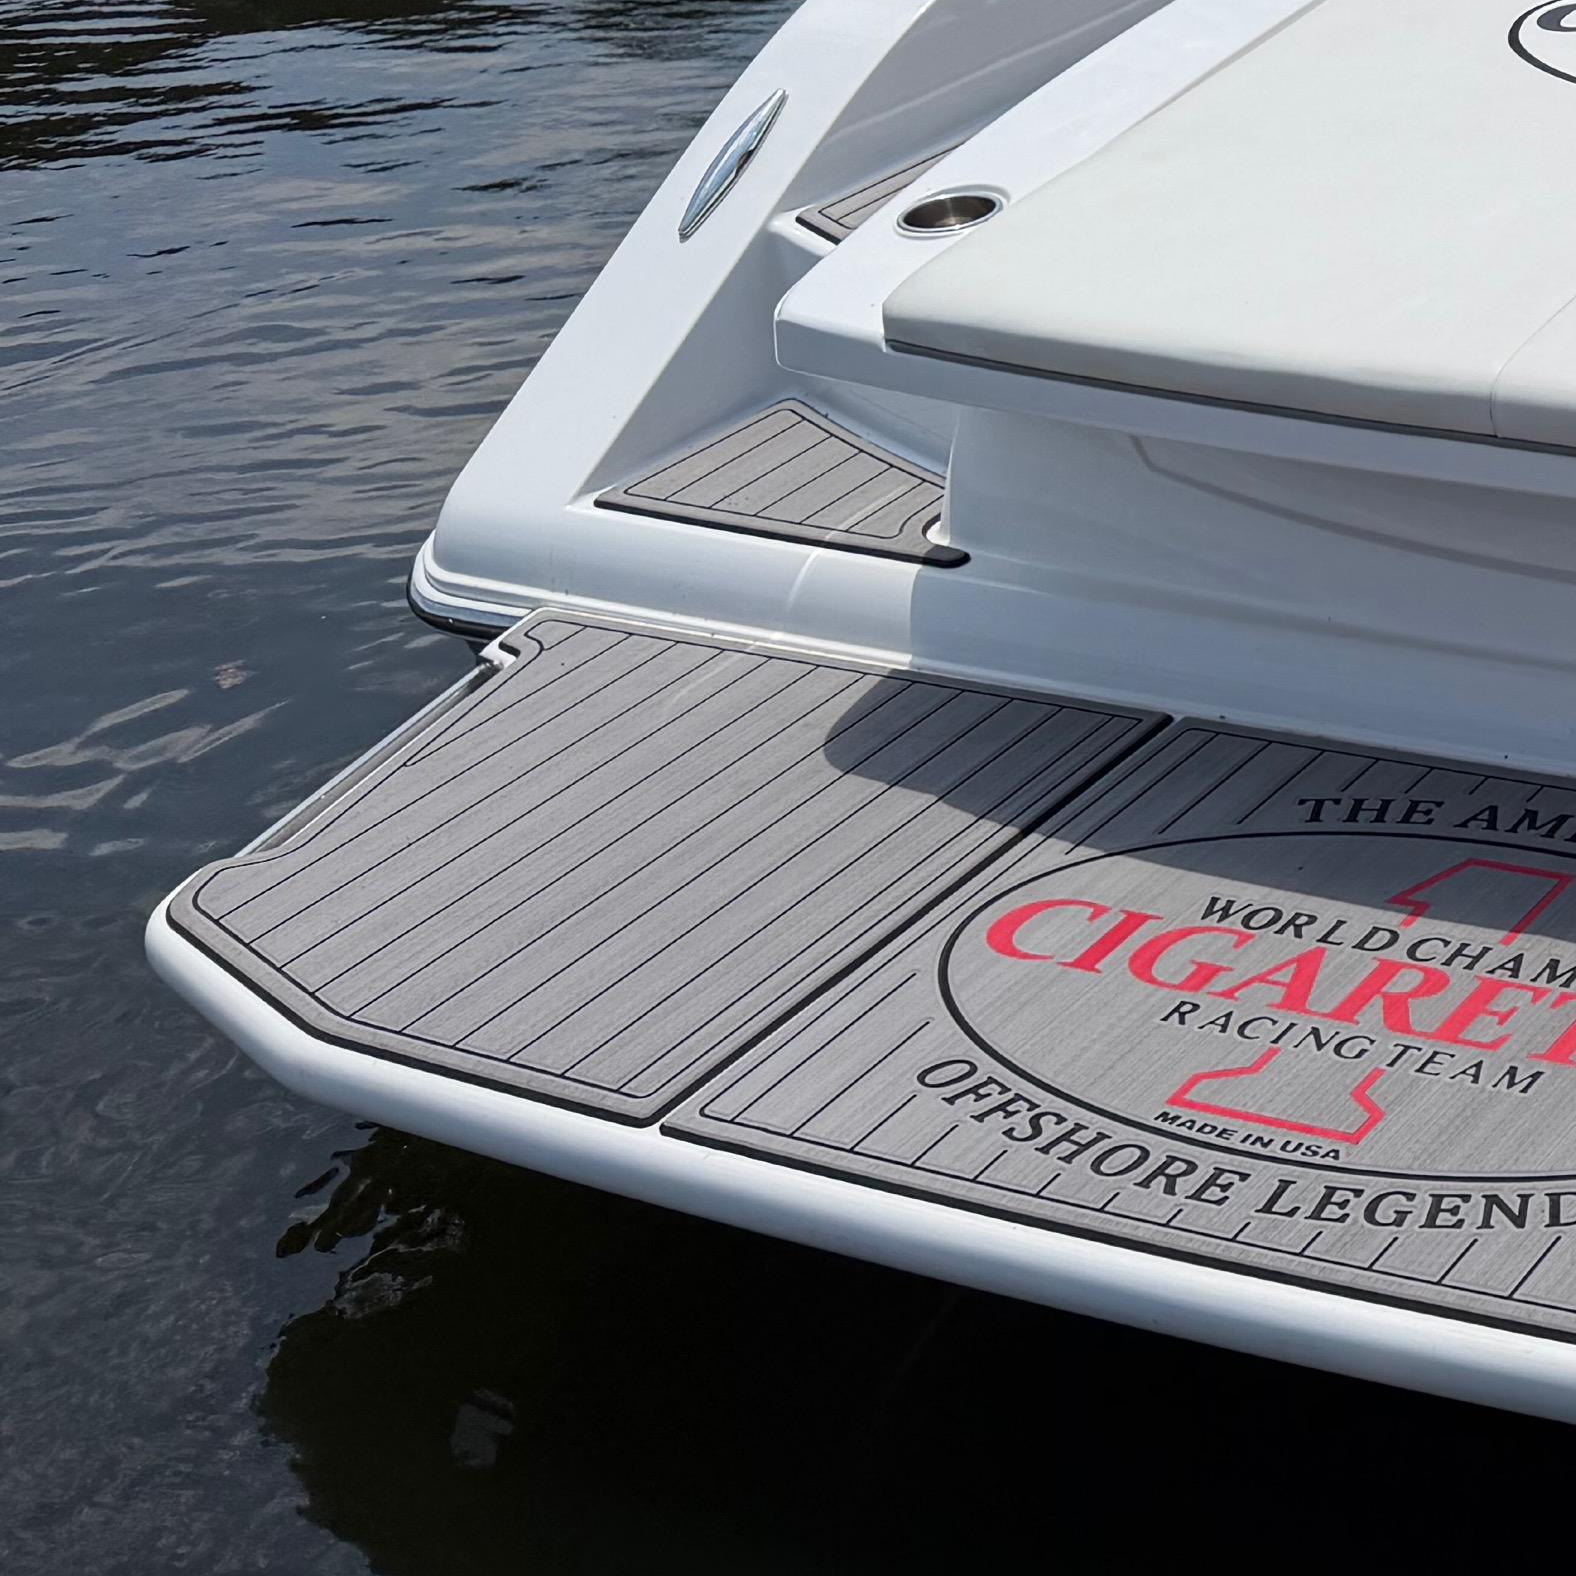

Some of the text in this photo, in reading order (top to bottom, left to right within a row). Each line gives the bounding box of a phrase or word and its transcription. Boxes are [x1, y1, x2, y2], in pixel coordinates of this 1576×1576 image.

[1297, 797, 1444, 824] THE
[1200, 896, 1399, 952] WORLD
[1160, 1000, 1545, 1095] RACING TEAM
[916, 1058, 1252, 1206] OFFSHORE
[1153, 1110, 1341, 1161] MADE IN USA
